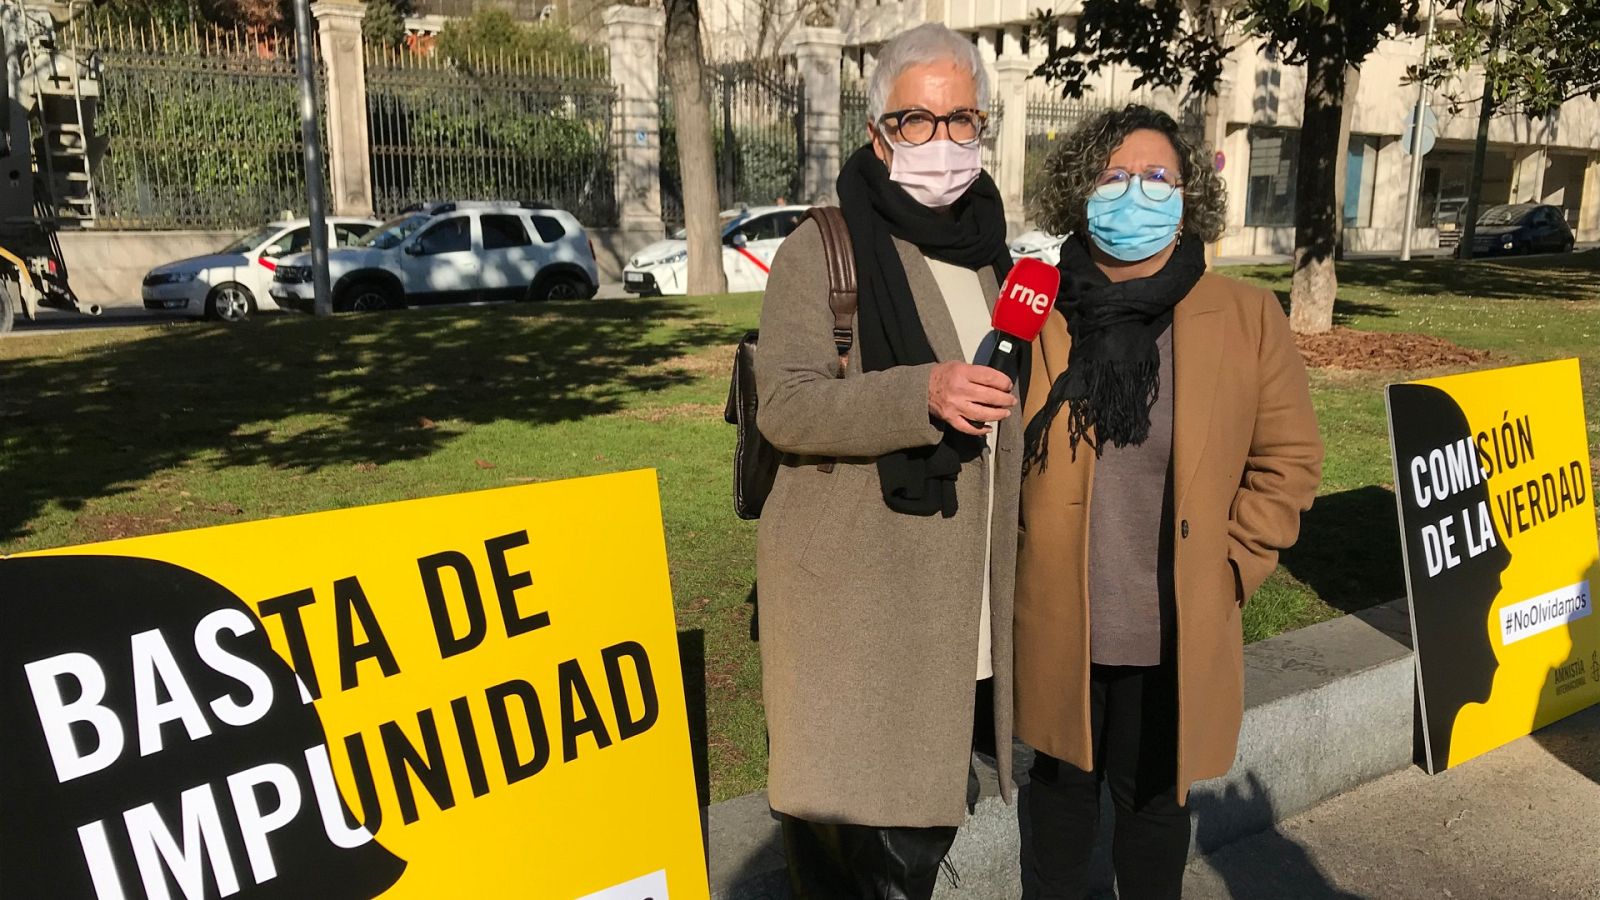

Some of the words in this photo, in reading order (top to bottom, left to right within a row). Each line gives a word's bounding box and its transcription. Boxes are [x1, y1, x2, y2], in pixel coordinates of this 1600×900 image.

[1009, 283, 1049, 315] rne
[1410, 410, 1535, 509] COMISIÓN
[1421, 515, 1461, 578] DE
[1462, 500, 1498, 558] LA
[1497, 460, 1586, 539] VERDAD
[23, 575, 402, 784] BASTA
[416, 529, 552, 659] DE
[1505, 593, 1587, 635] #NoOlvidamos
[77, 640, 661, 900] IMPUNIDAD
